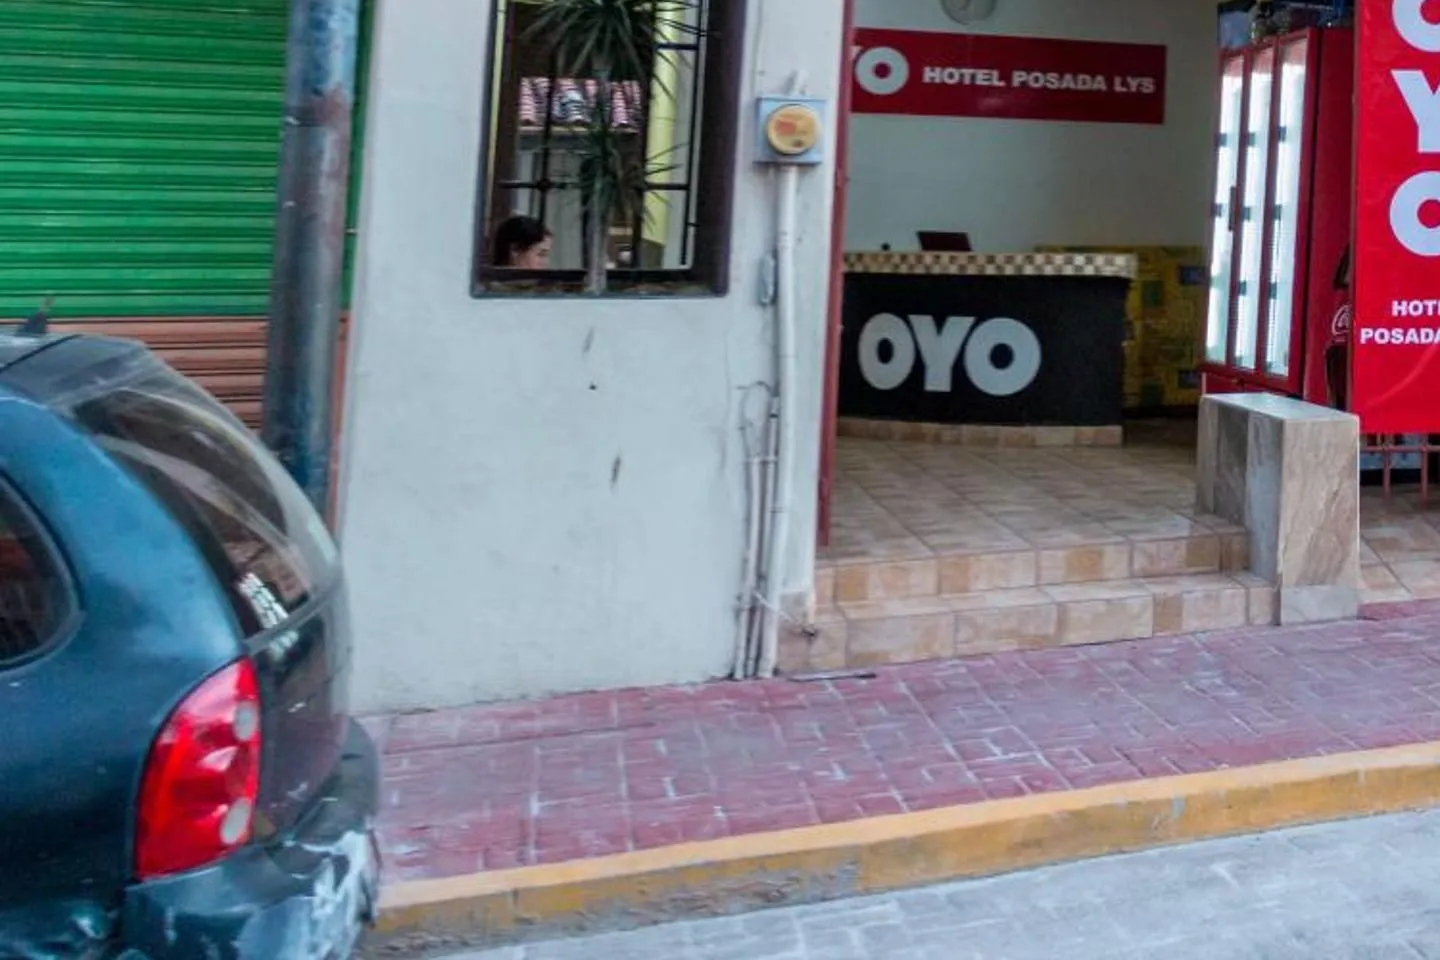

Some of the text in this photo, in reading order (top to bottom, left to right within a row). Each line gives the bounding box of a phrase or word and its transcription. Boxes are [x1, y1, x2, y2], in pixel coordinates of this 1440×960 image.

[922, 65, 1006, 88] HOTEL
[1011, 71, 1107, 92] POSADA
[1113, 76, 1156, 95] LYS
[858, 312, 1042, 396] OYO
